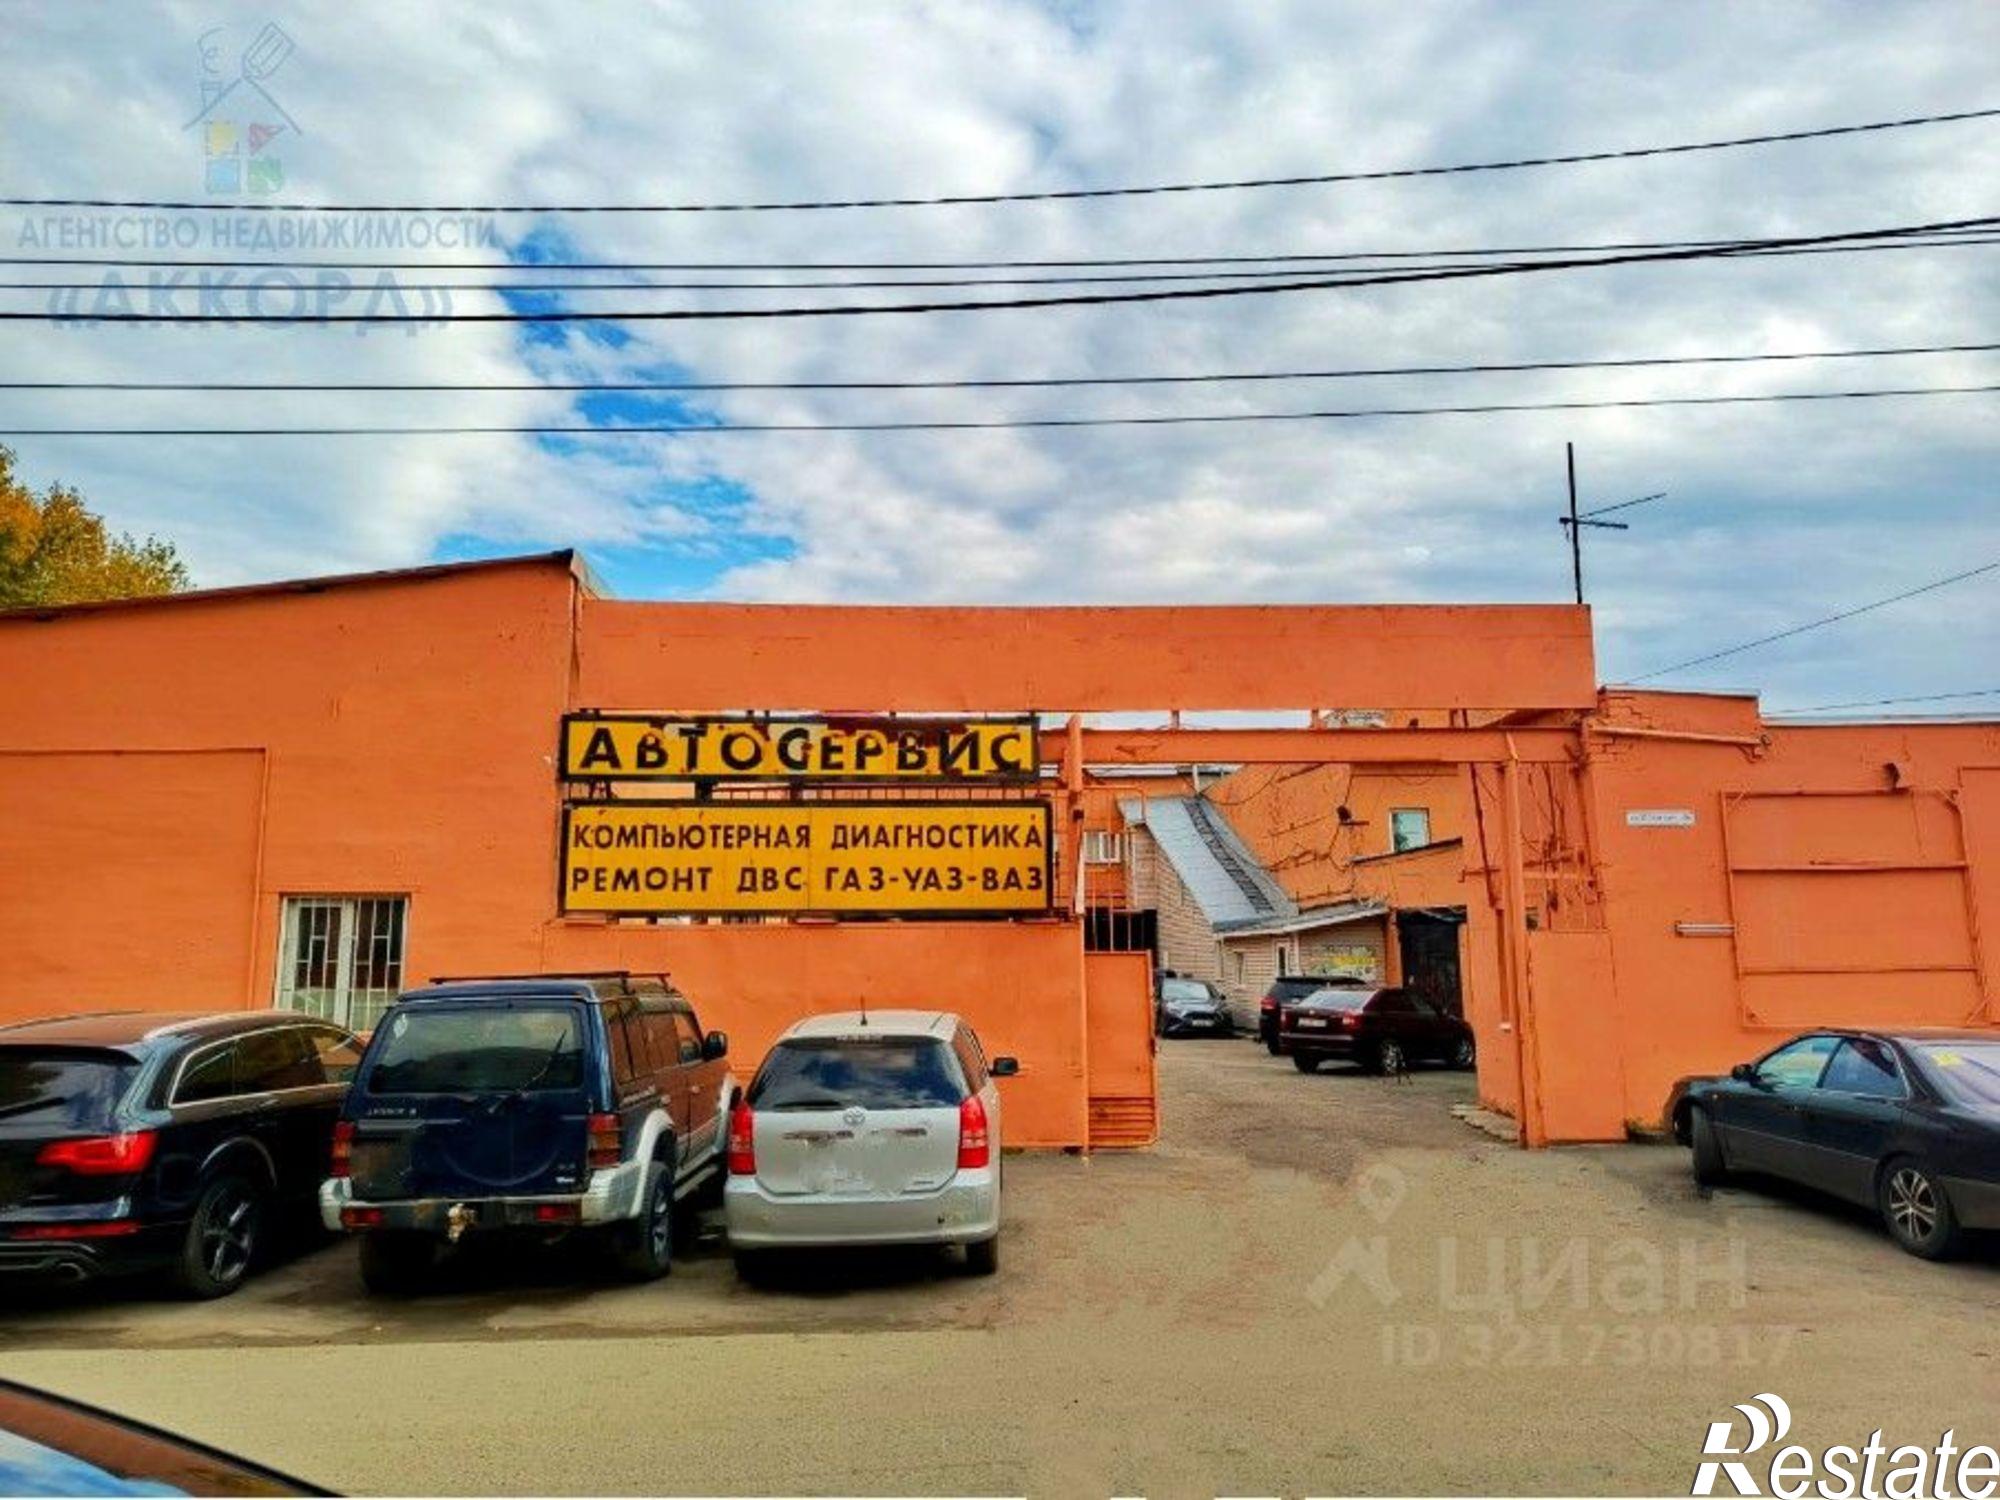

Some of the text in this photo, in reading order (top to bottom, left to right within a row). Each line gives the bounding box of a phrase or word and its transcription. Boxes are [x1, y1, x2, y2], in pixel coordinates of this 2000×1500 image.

[579, 725, 1022, 773] АВТОСЕРВИС
[573, 823, 1043, 850] КОМПЬЮТЕРНАЯ ДИАГНОСТИКА
[571, 866, 1043, 893] РЕМОНТ ДВС ГАЗ-УАЗ-ВАЗ
